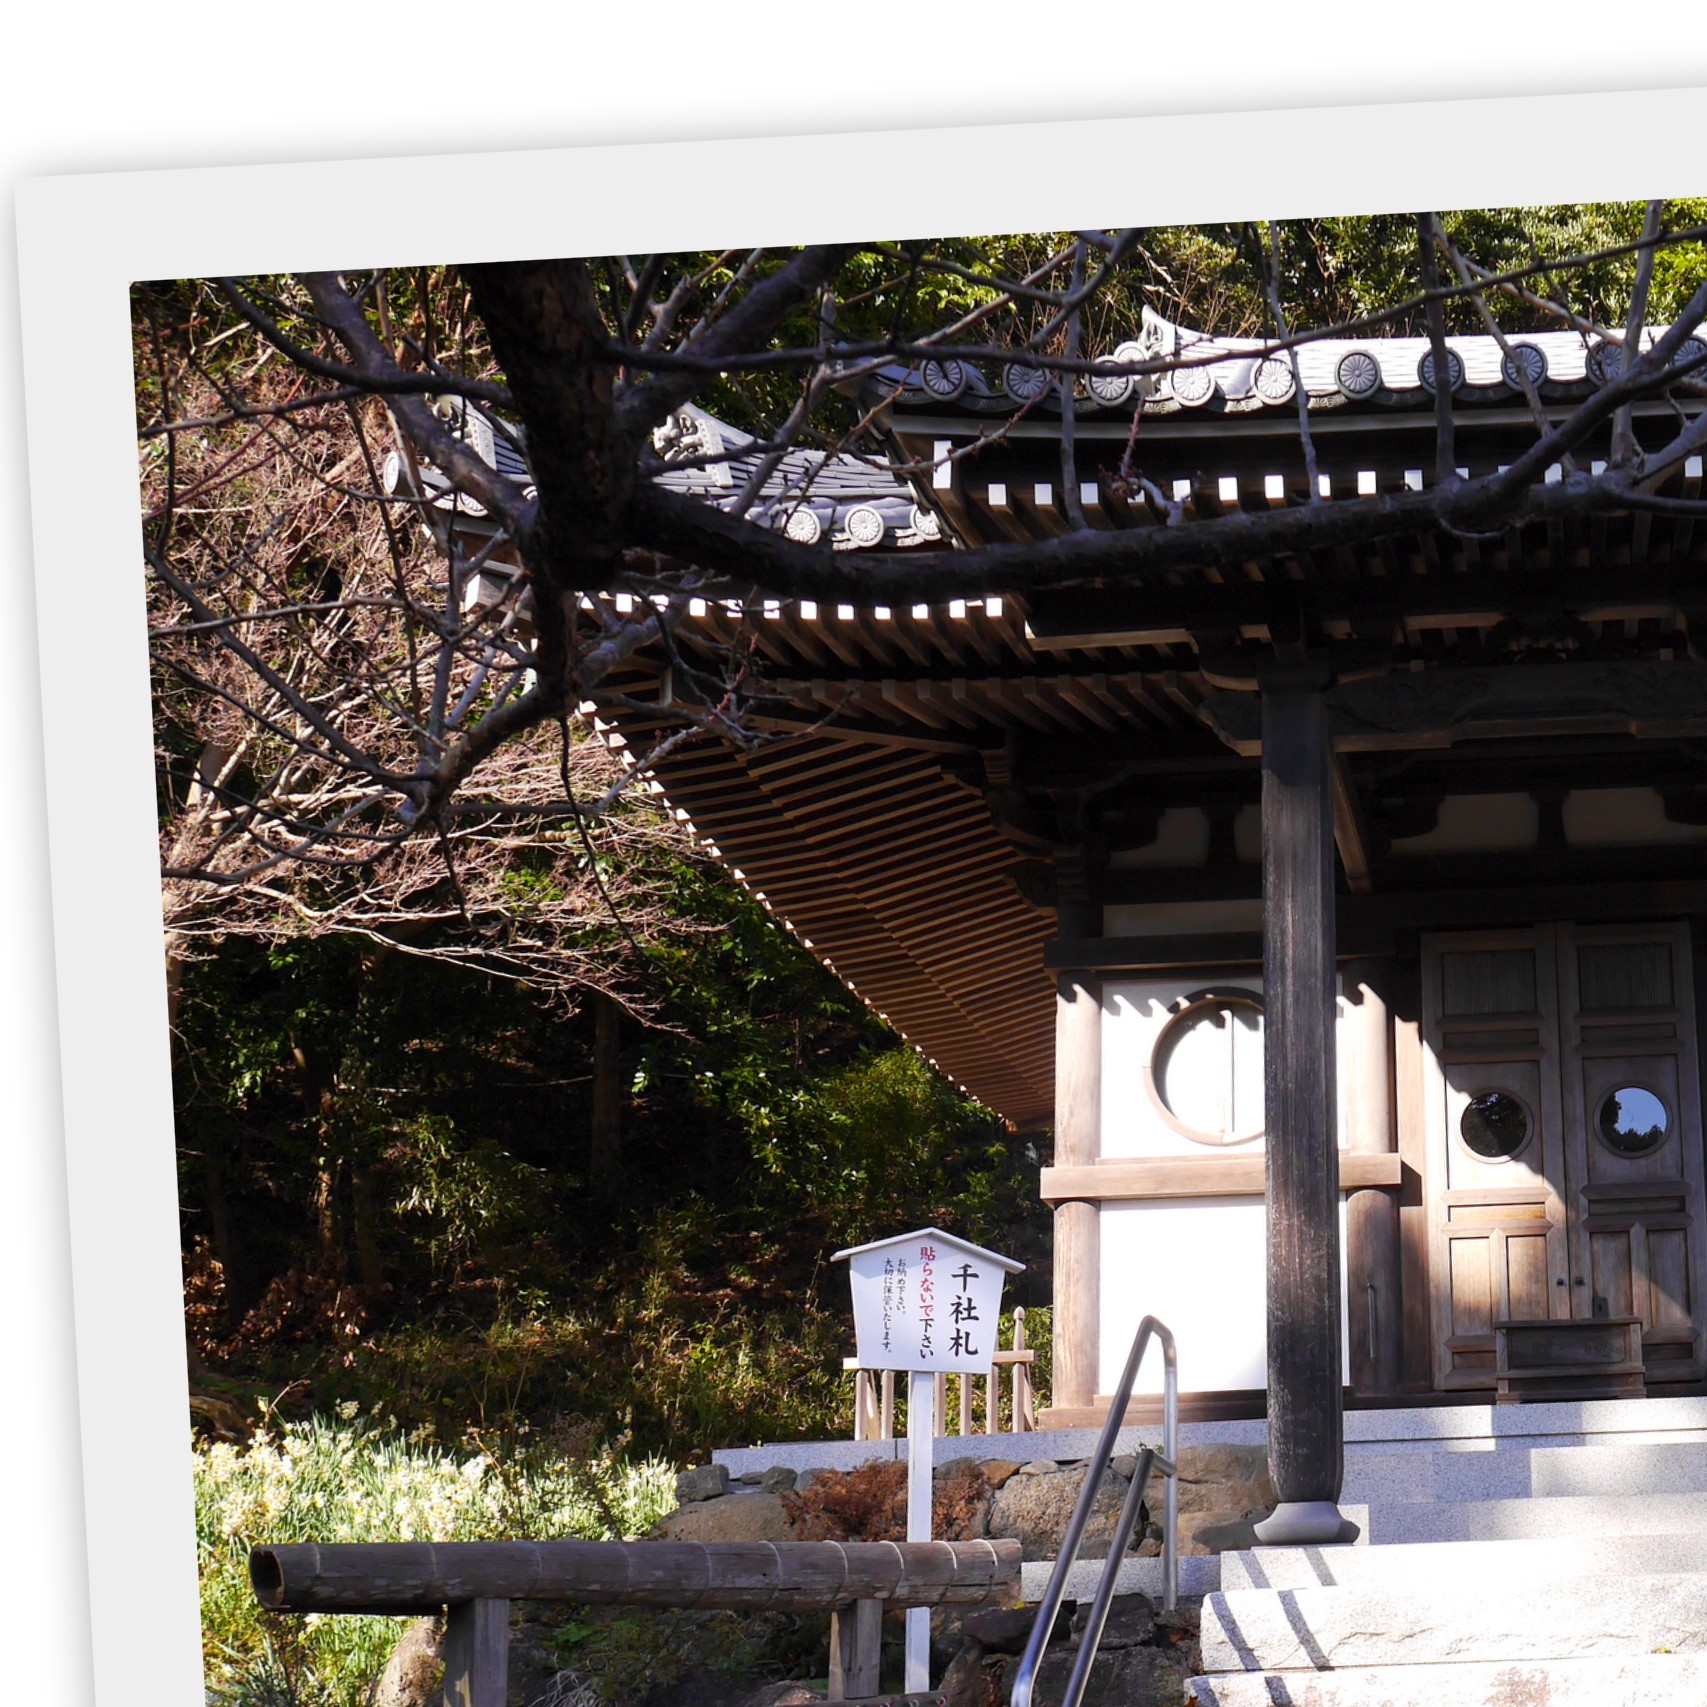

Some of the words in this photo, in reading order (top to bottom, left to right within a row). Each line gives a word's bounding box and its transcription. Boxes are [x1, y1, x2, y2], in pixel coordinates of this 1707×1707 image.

[918, 1246, 936, 1359] 貼らないで下さい
[947, 1263, 980, 1358] 千社札
